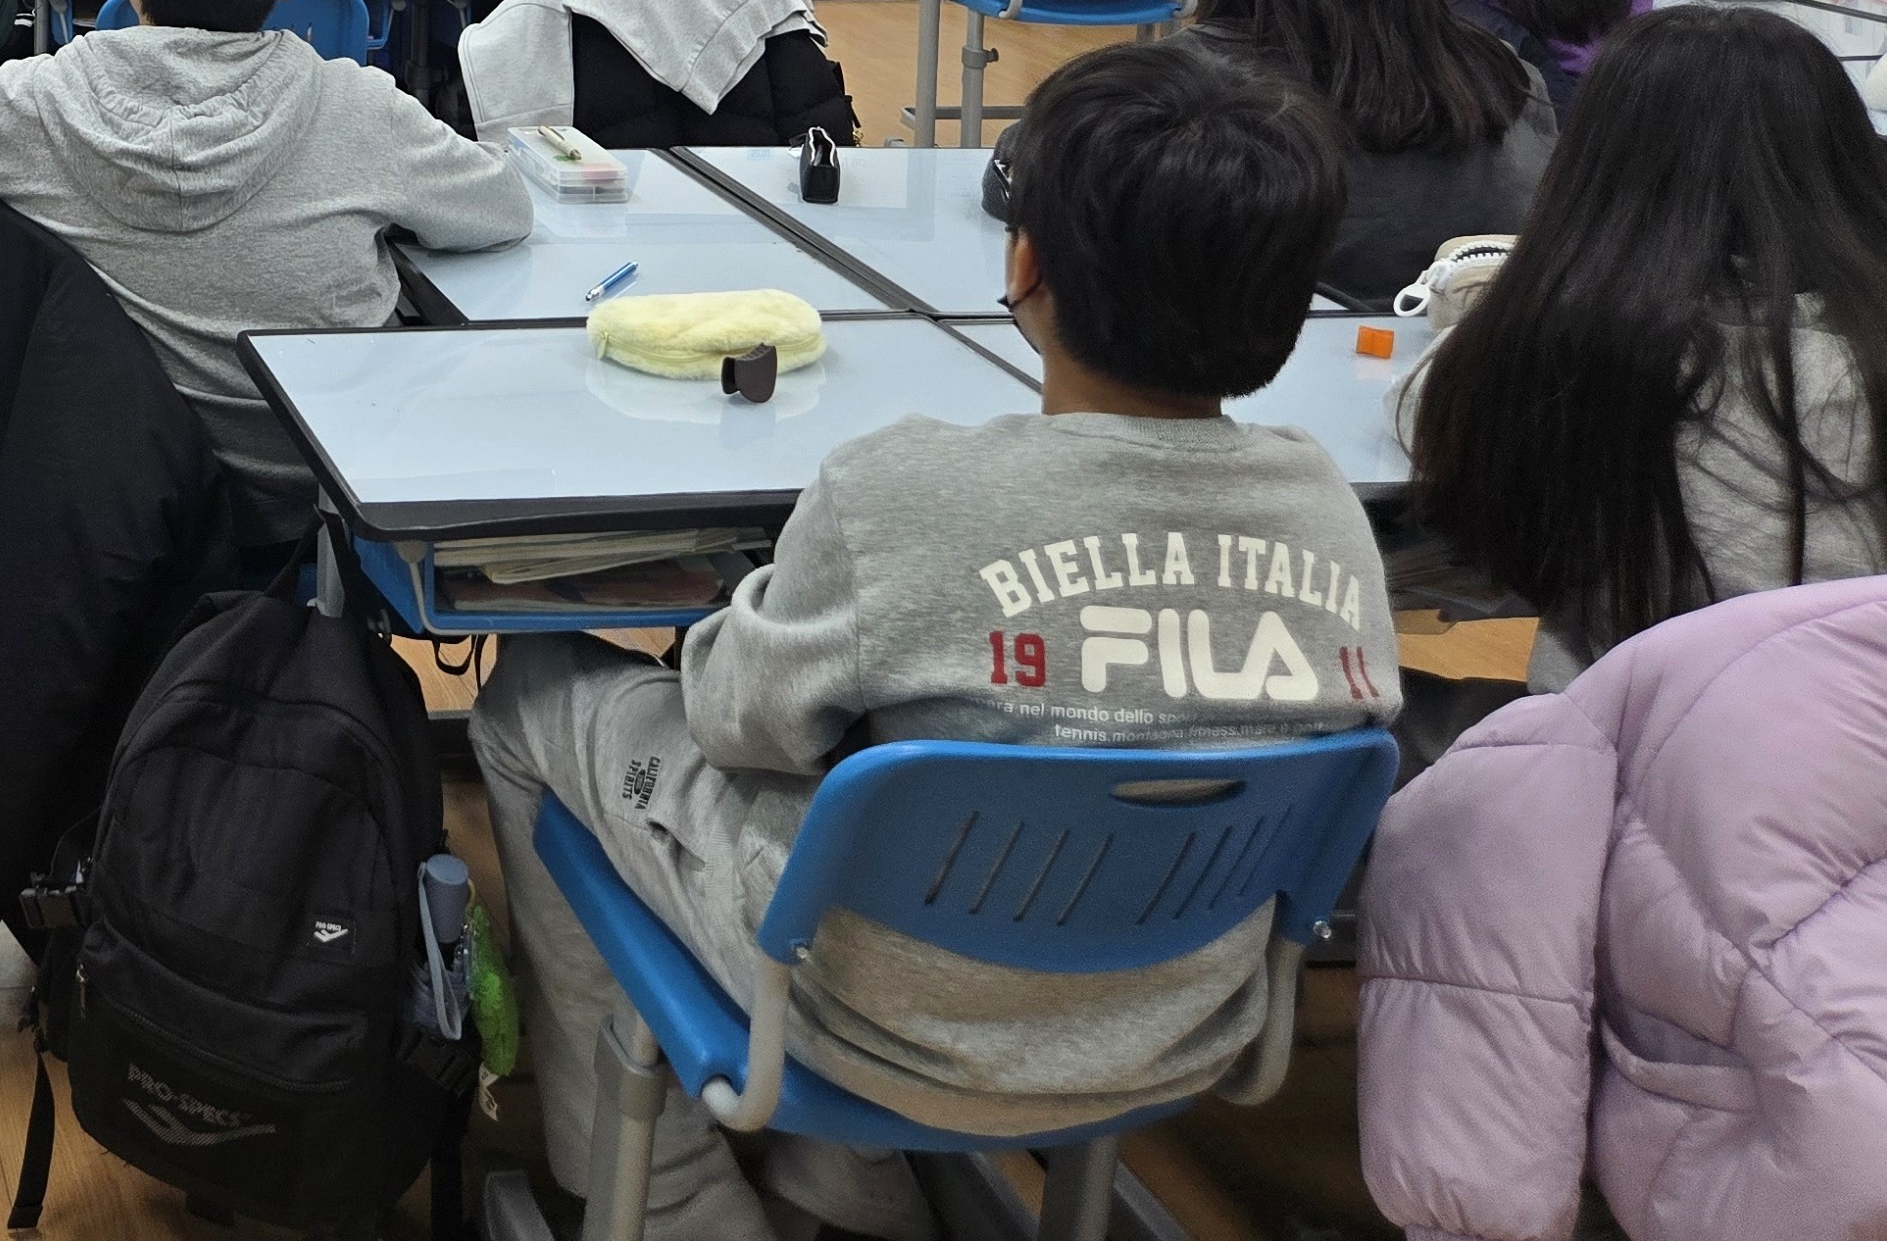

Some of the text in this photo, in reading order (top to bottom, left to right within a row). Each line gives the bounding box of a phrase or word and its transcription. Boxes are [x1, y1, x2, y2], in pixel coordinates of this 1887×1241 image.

[979, 531, 1362, 632] BIELLA ITALIA
[989, 630, 1047, 687] 19
[1080, 605, 1319, 701] FILA
[1019, 702, 1045, 717] nel
[1050, 706, 1109, 723] mondo
[1114, 708, 1154, 725] dello
[622, 759, 642, 800] SPIRITS
[634, 756, 661, 811] CALIFORNIA
